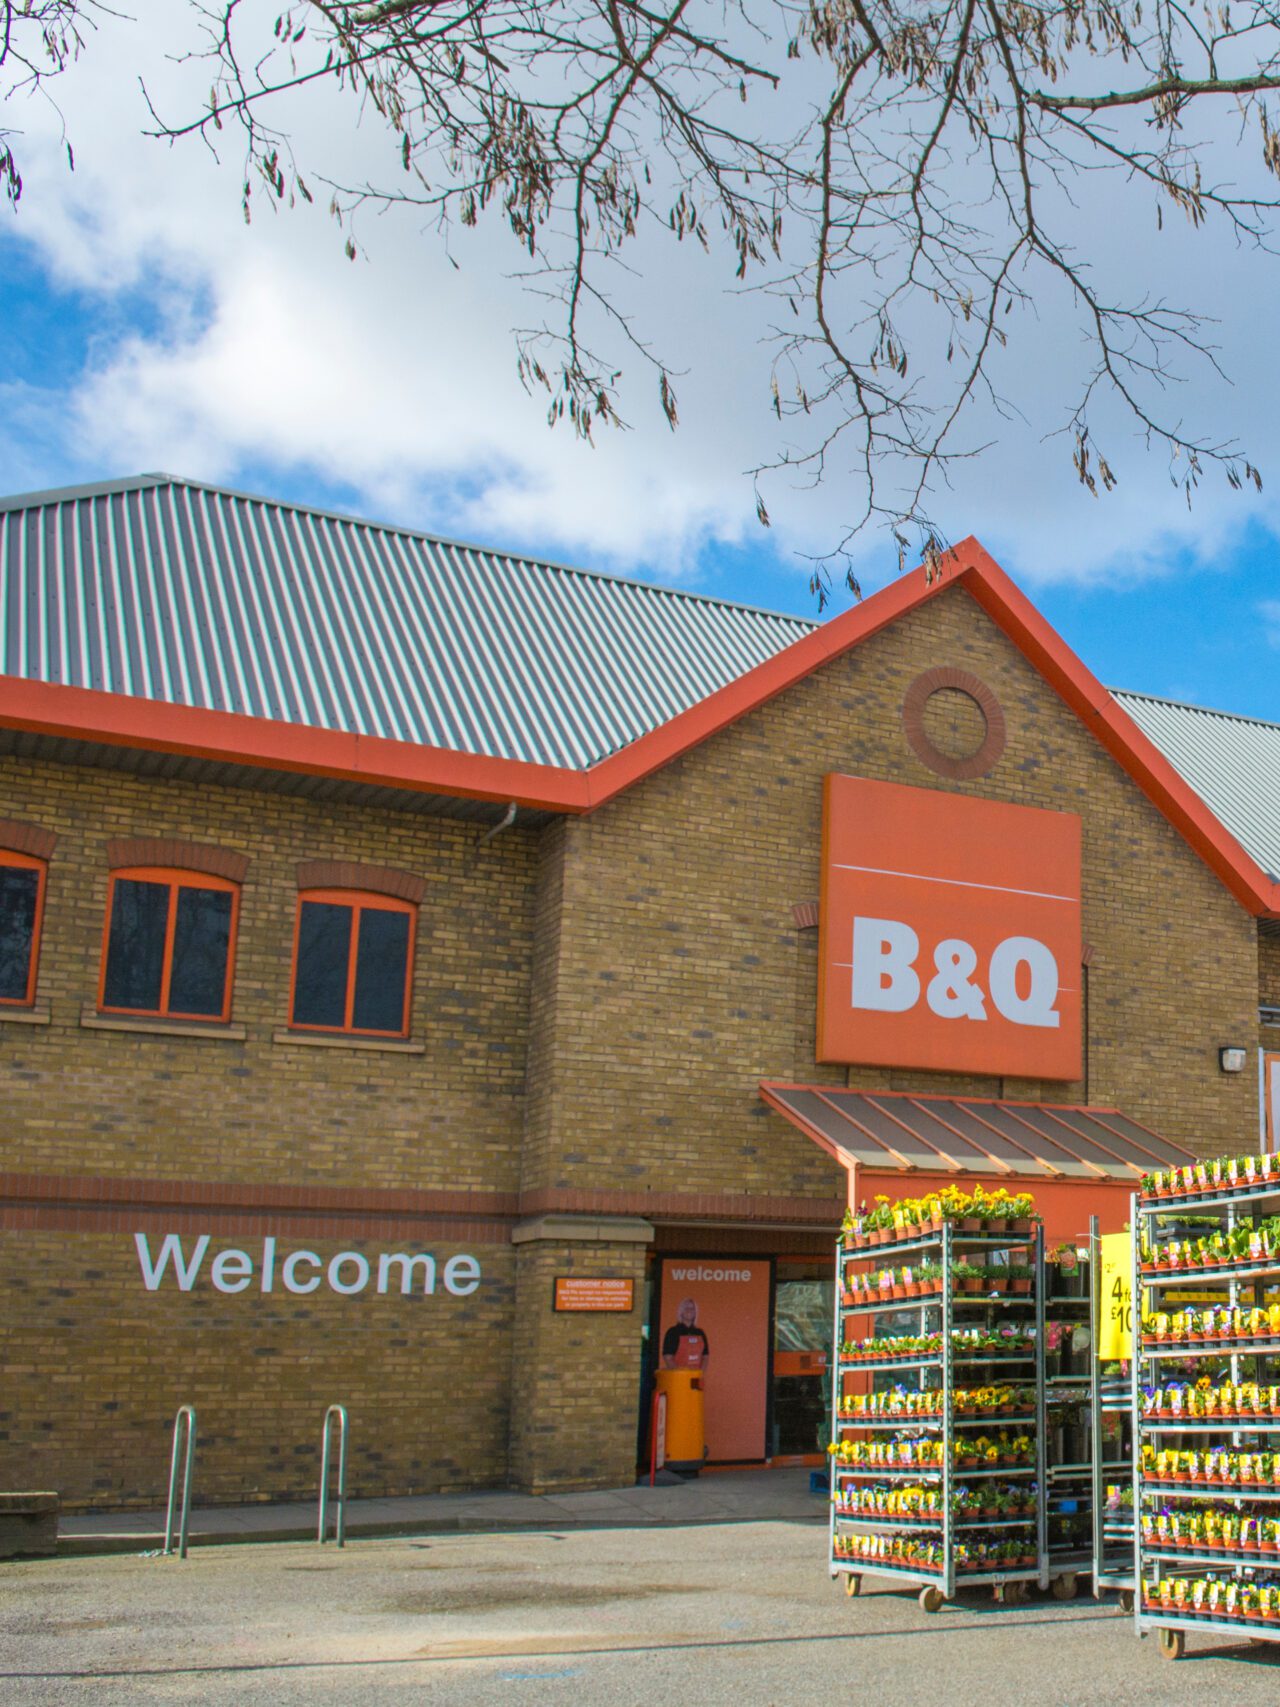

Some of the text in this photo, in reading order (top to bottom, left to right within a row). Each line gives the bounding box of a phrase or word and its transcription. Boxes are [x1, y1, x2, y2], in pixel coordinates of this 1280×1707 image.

[851, 916, 1060, 1028] B&Q
[134, 1233, 481, 1296] Welcome
[671, 1266, 752, 1281] welcome
[566, 1280, 625, 1289] customer notice
[1111, 1276, 1123, 1303] 4
